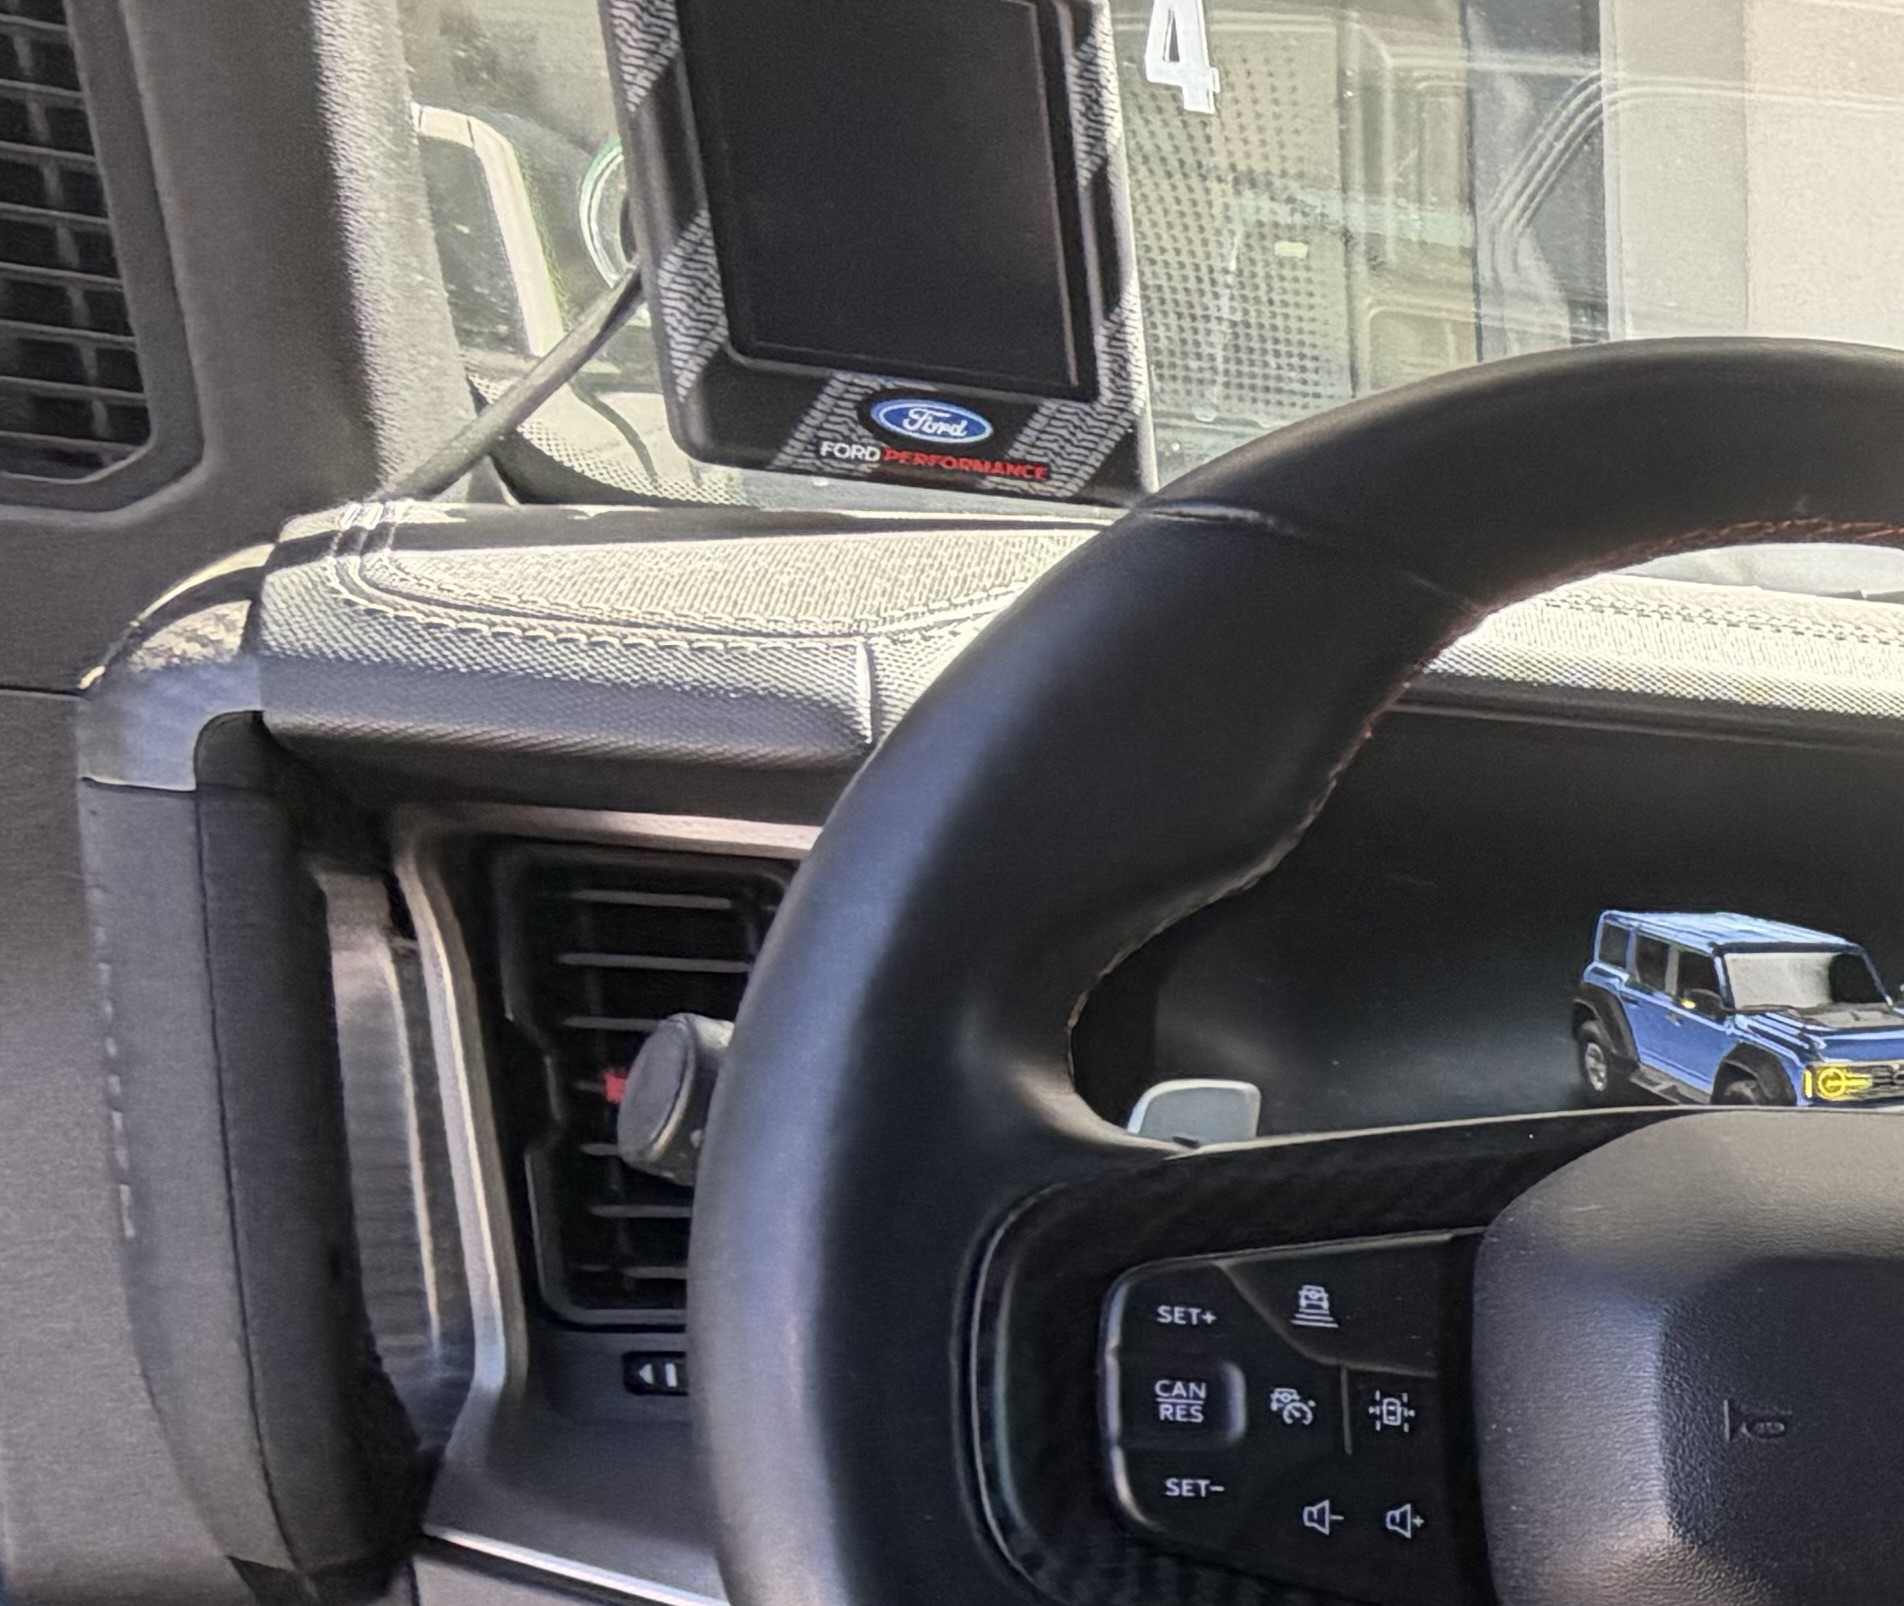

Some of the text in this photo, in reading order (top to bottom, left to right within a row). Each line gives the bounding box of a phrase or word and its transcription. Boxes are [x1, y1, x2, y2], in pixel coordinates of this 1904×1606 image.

[1144, 0, 1221, 114] 4
[902, 407, 968, 437] Ford
[819, 441, 1049, 480] FORD PERFORMANCE
[1156, 1304, 1217, 1326] SET+
[1154, 1379, 1207, 1399] CAN
[1158, 1404, 1205, 1424] RES
